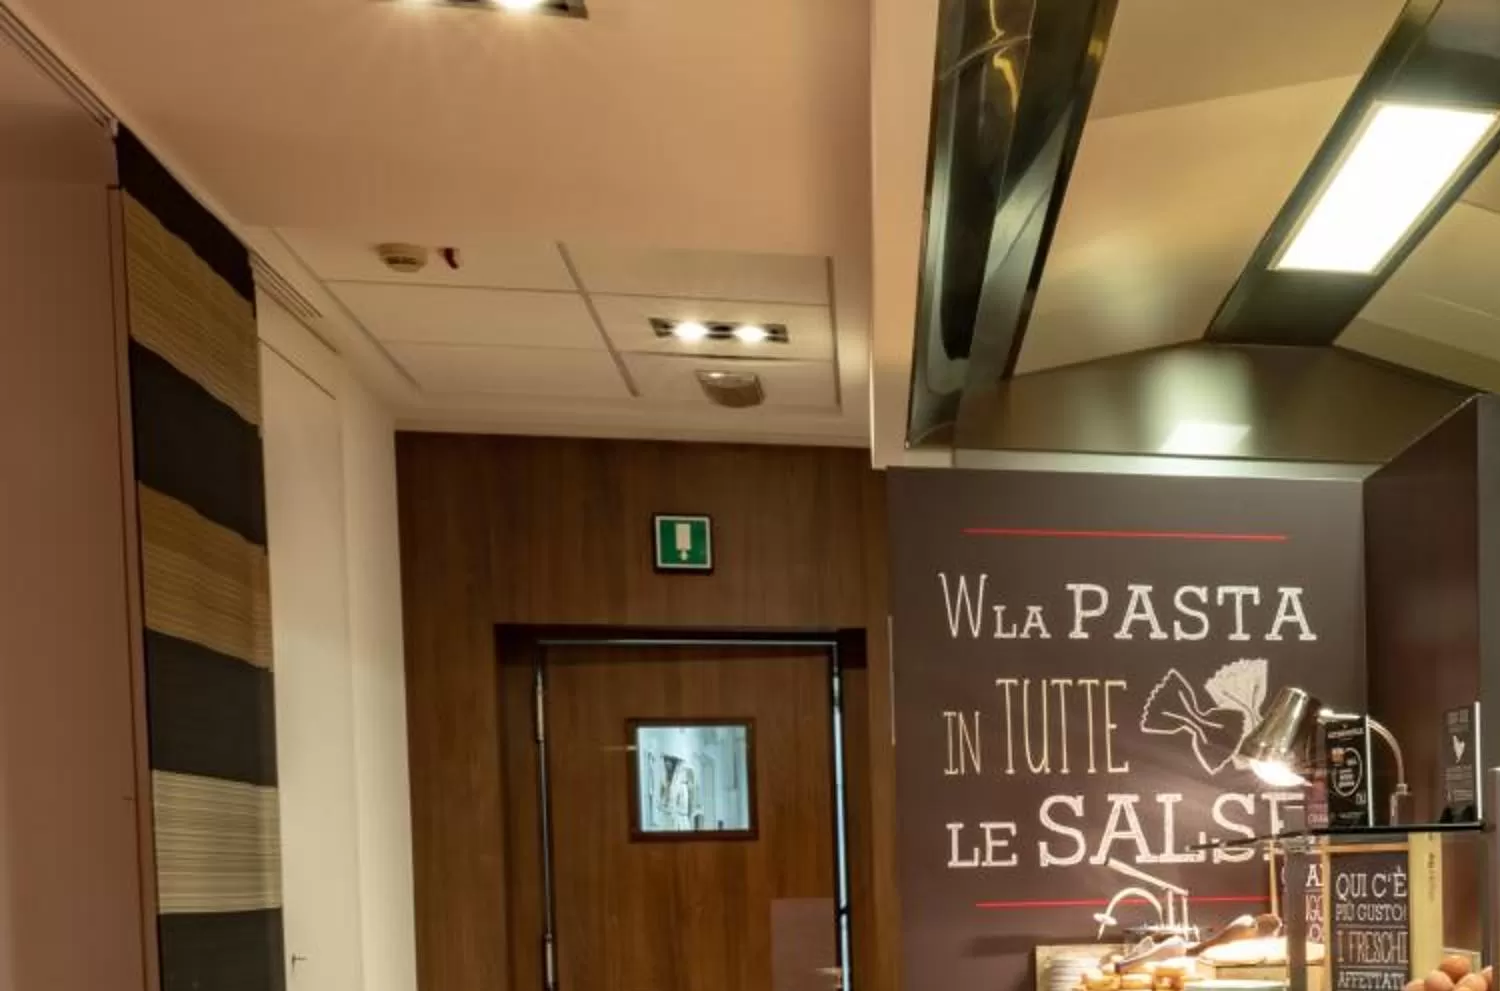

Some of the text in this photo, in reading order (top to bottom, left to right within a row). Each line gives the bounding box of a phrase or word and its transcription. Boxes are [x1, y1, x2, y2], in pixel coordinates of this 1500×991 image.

[938, 572, 1317, 641] W LA PASTA
[943, 679, 1129, 775] IN TUTTE
[946, 822, 1018, 868] LE
[1336, 873, 1368, 901] QUI
[1349, 930, 1408, 964] FRESCHI
